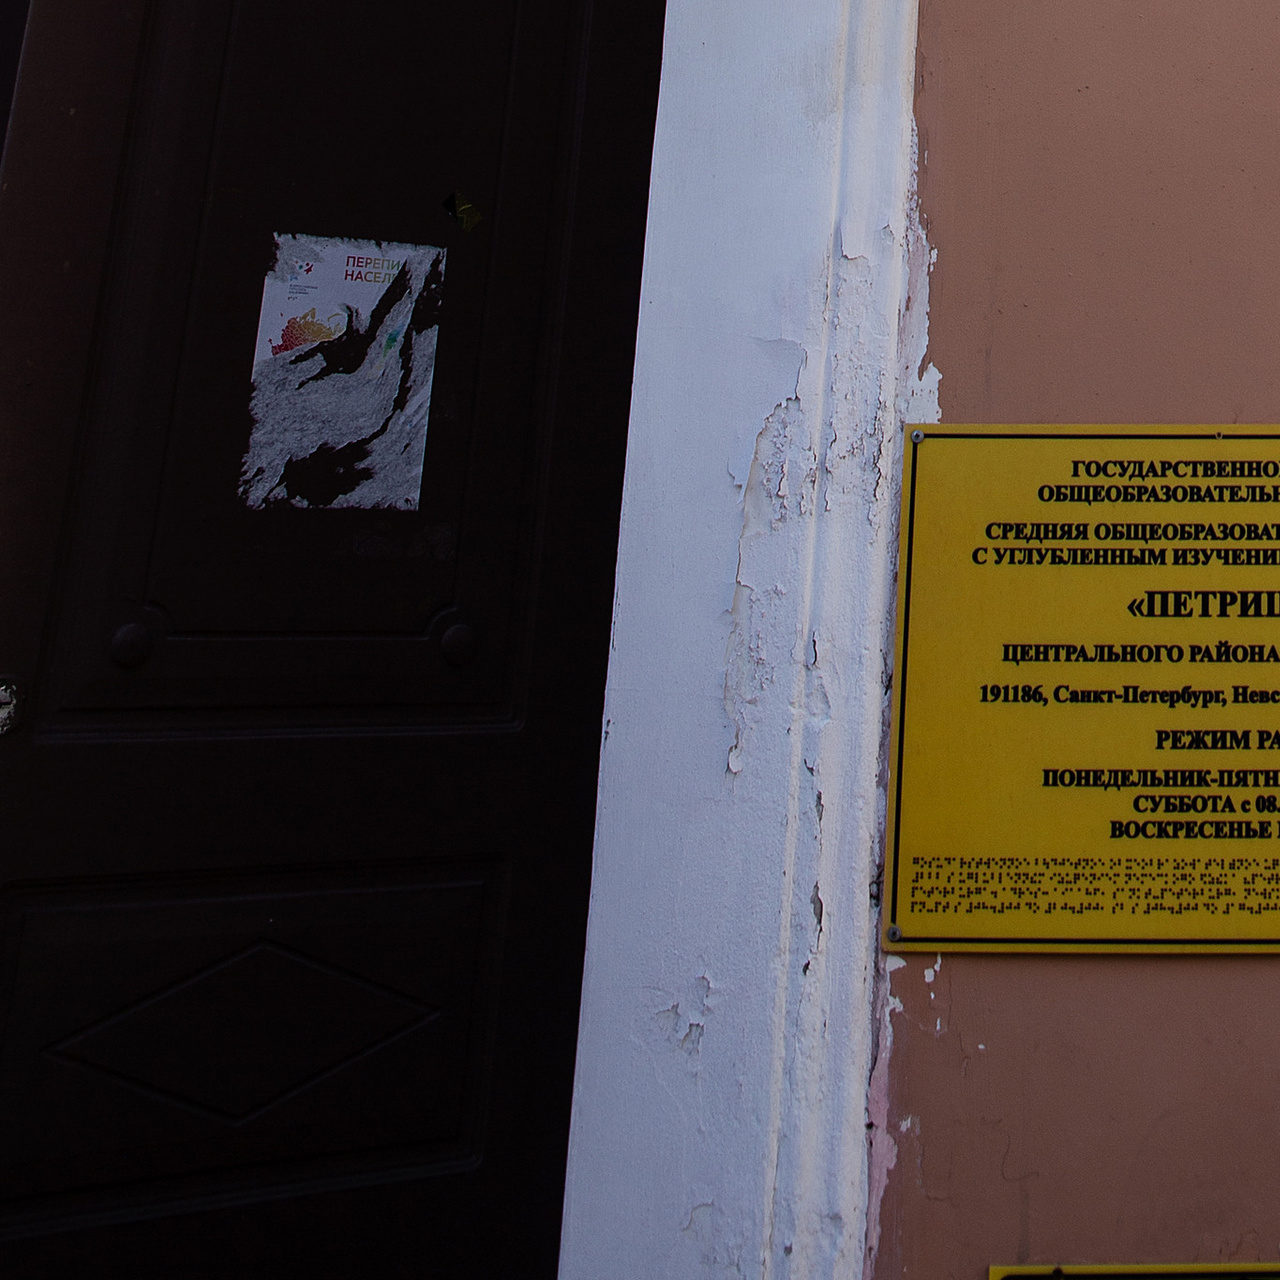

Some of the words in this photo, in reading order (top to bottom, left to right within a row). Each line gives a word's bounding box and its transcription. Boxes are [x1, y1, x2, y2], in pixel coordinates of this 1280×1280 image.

[984, 521, 1090, 545] СРЕДНЯЯ
[971, 546, 989, 566] С
[991, 547, 1168, 567] УГЛУБЛЕННЫМ
[1001, 643, 1185, 668] ЦЕНТРАЛЬНОГО
[979, 683, 1049, 708] 191186,
[1052, 684, 1228, 710] Санкт-Петербург,
[1154, 729, 1252, 752] РЕЖИМ
[1132, 794, 1238, 815] СУББОТА
[1239, 799, 1252, 815] с
[1108, 819, 1273, 841] ВОСКРЕСЕНЬЕ
